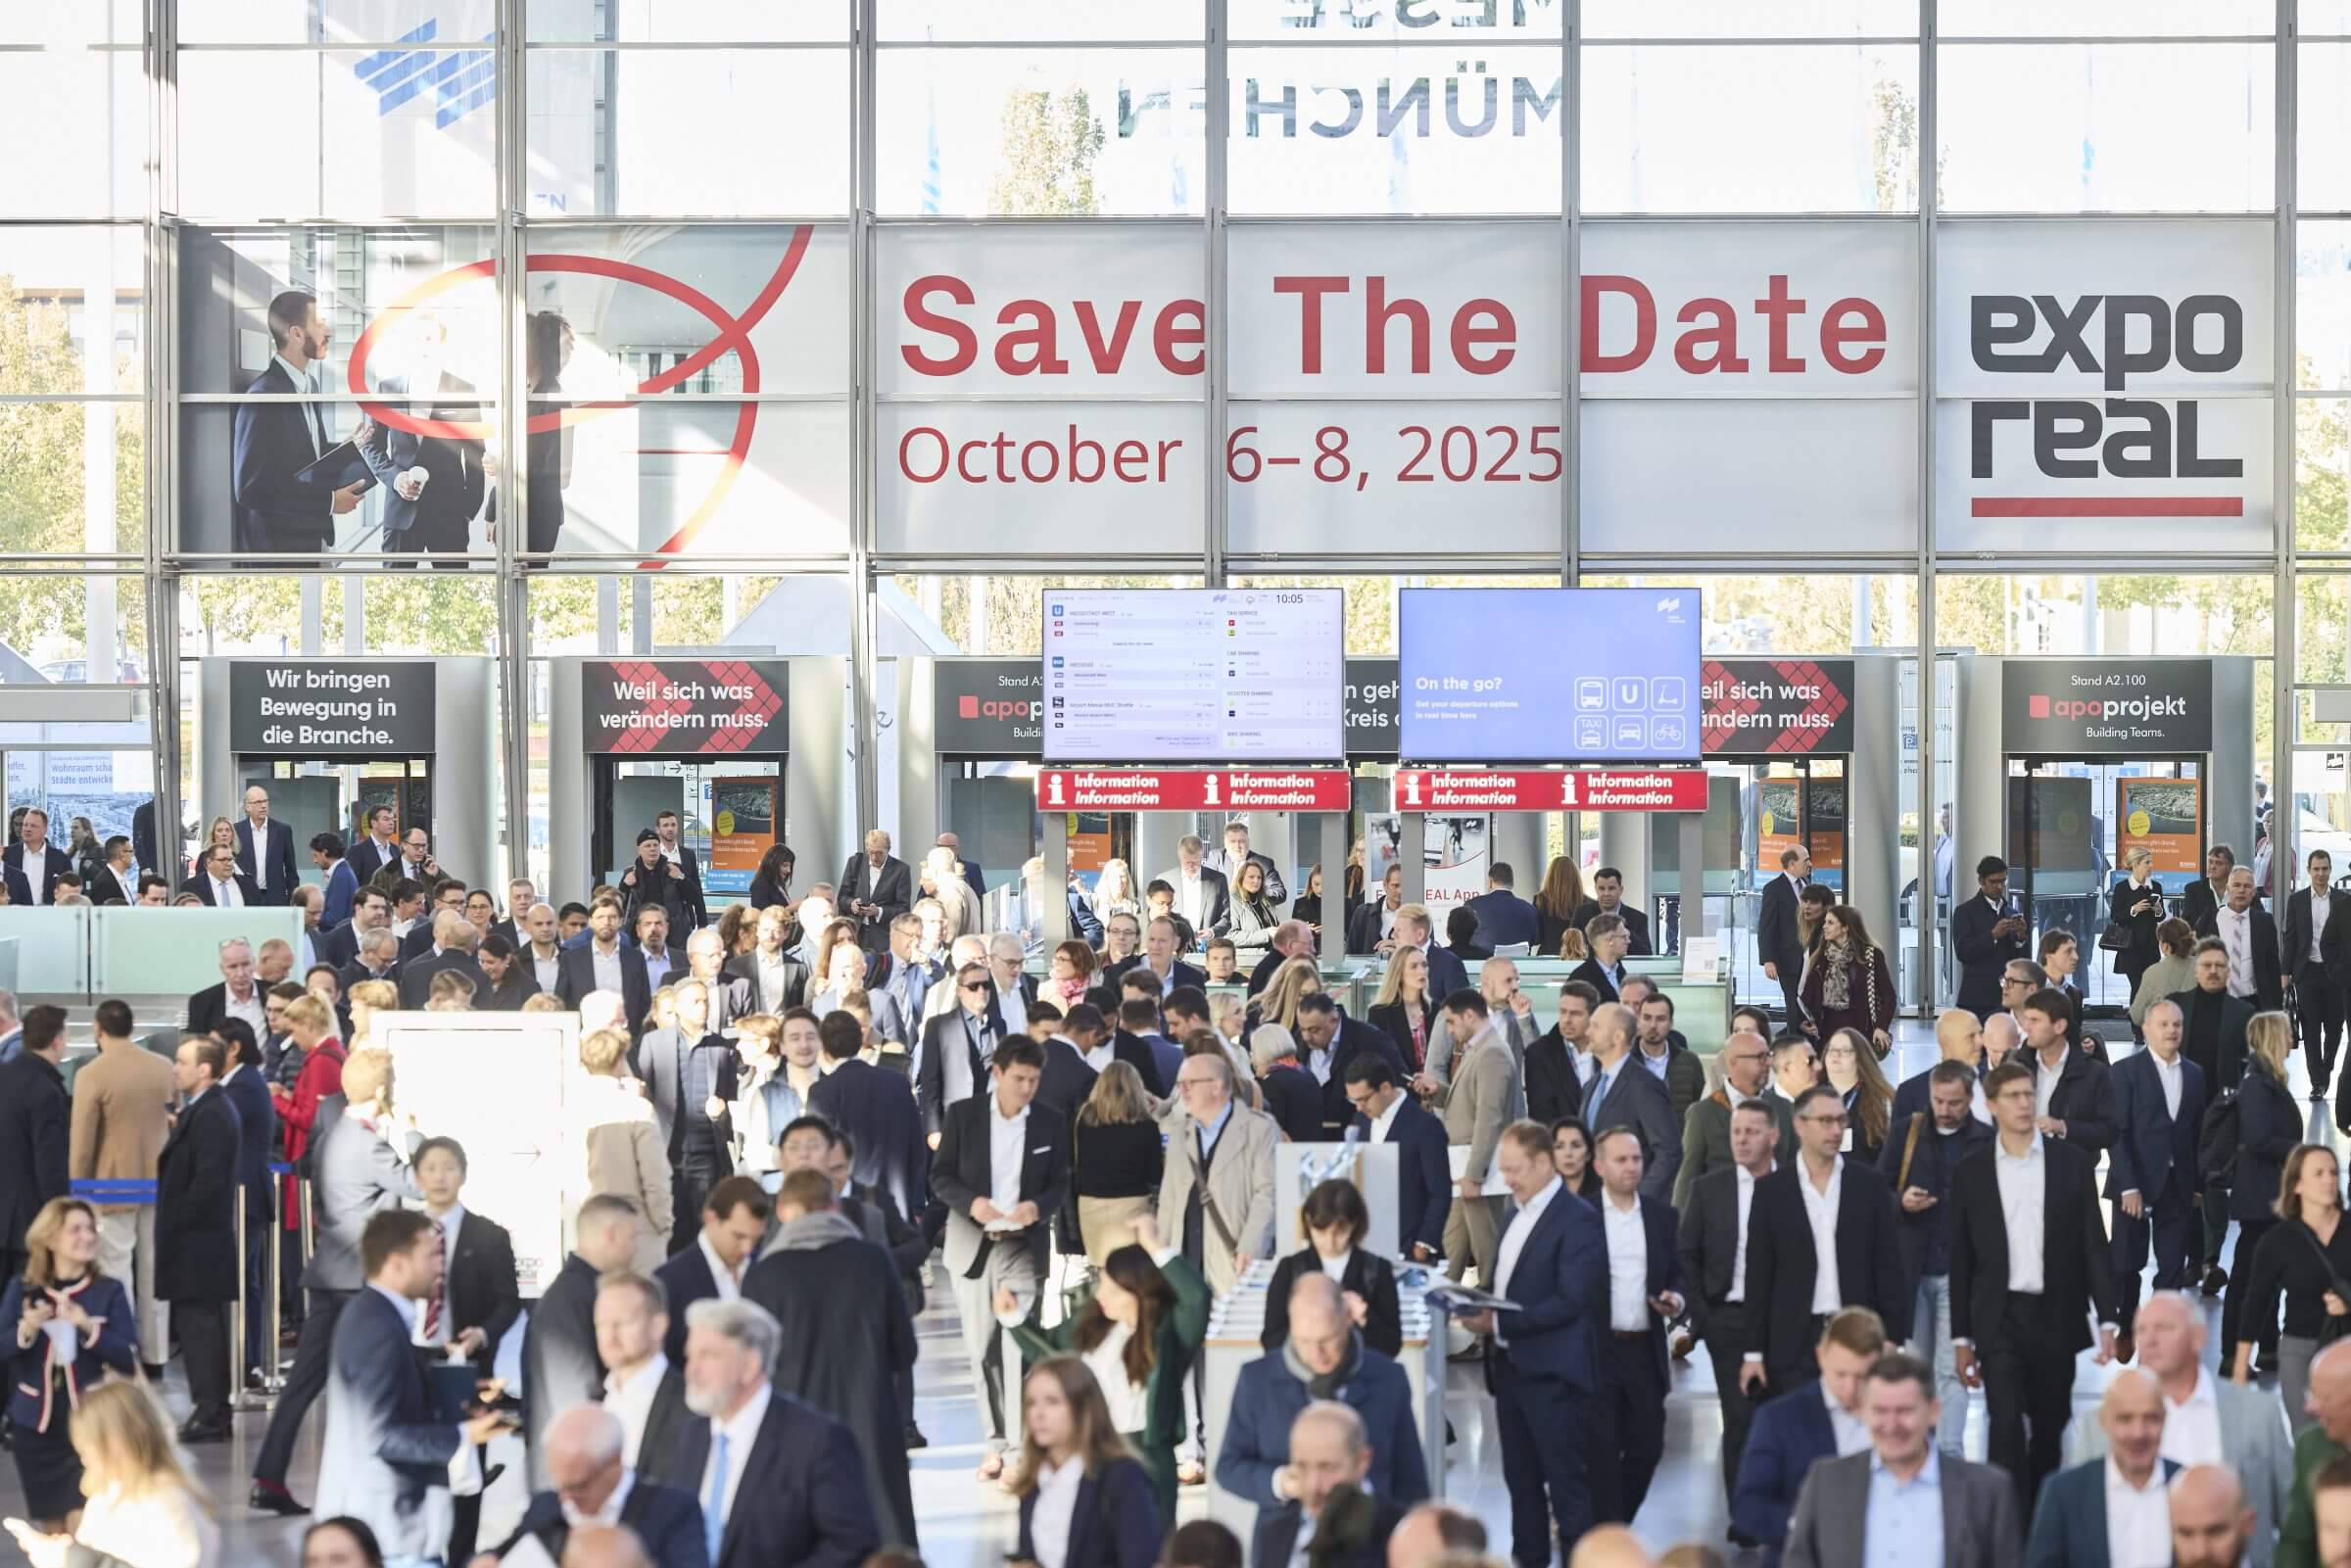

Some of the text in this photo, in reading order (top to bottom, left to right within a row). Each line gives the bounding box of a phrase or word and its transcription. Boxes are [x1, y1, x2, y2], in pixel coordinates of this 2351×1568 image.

[900, 274, 1888, 376] Save The Date
[1971, 294, 2243, 392] expo
[898, 424, 1183, 484] October
[1397, 426, 1562, 482] 2025
[1276, 594, 1304, 604] 10:05
[265, 669, 391, 693] Wir bringen
[998, 675, 1029, 687] Stand
[1415, 676, 1503, 692] On the go?
[2070, 675, 2146, 687] Stand A2.100
[613, 680, 753, 700] Weil sich was
[1730, 681, 1773, 699] sich
[1779, 686, 1821, 699] was
[260, 696, 397, 721] Bewegung in
[2053, 694, 2186, 722] apoprojekt
[600, 708, 768, 729] verändern muss.
[1579, 719, 1603, 730] TAXI
[1778, 714, 1835, 728] muss.
[262, 725, 394, 745] die Branche.
[1013, 727, 1042, 737] Buildi
[2086, 727, 2165, 740] Building Teams.
[1075, 774, 1159, 788] Information
[1229, 774, 1315, 788] Information
[1431, 774, 1515, 788] Information
[1587, 774, 1672, 788] Information
[1075, 791, 1160, 805] Information
[1230, 791, 1316, 805] Information
[1431, 791, 1516, 805] Information
[1588, 791, 1673, 805] Information
